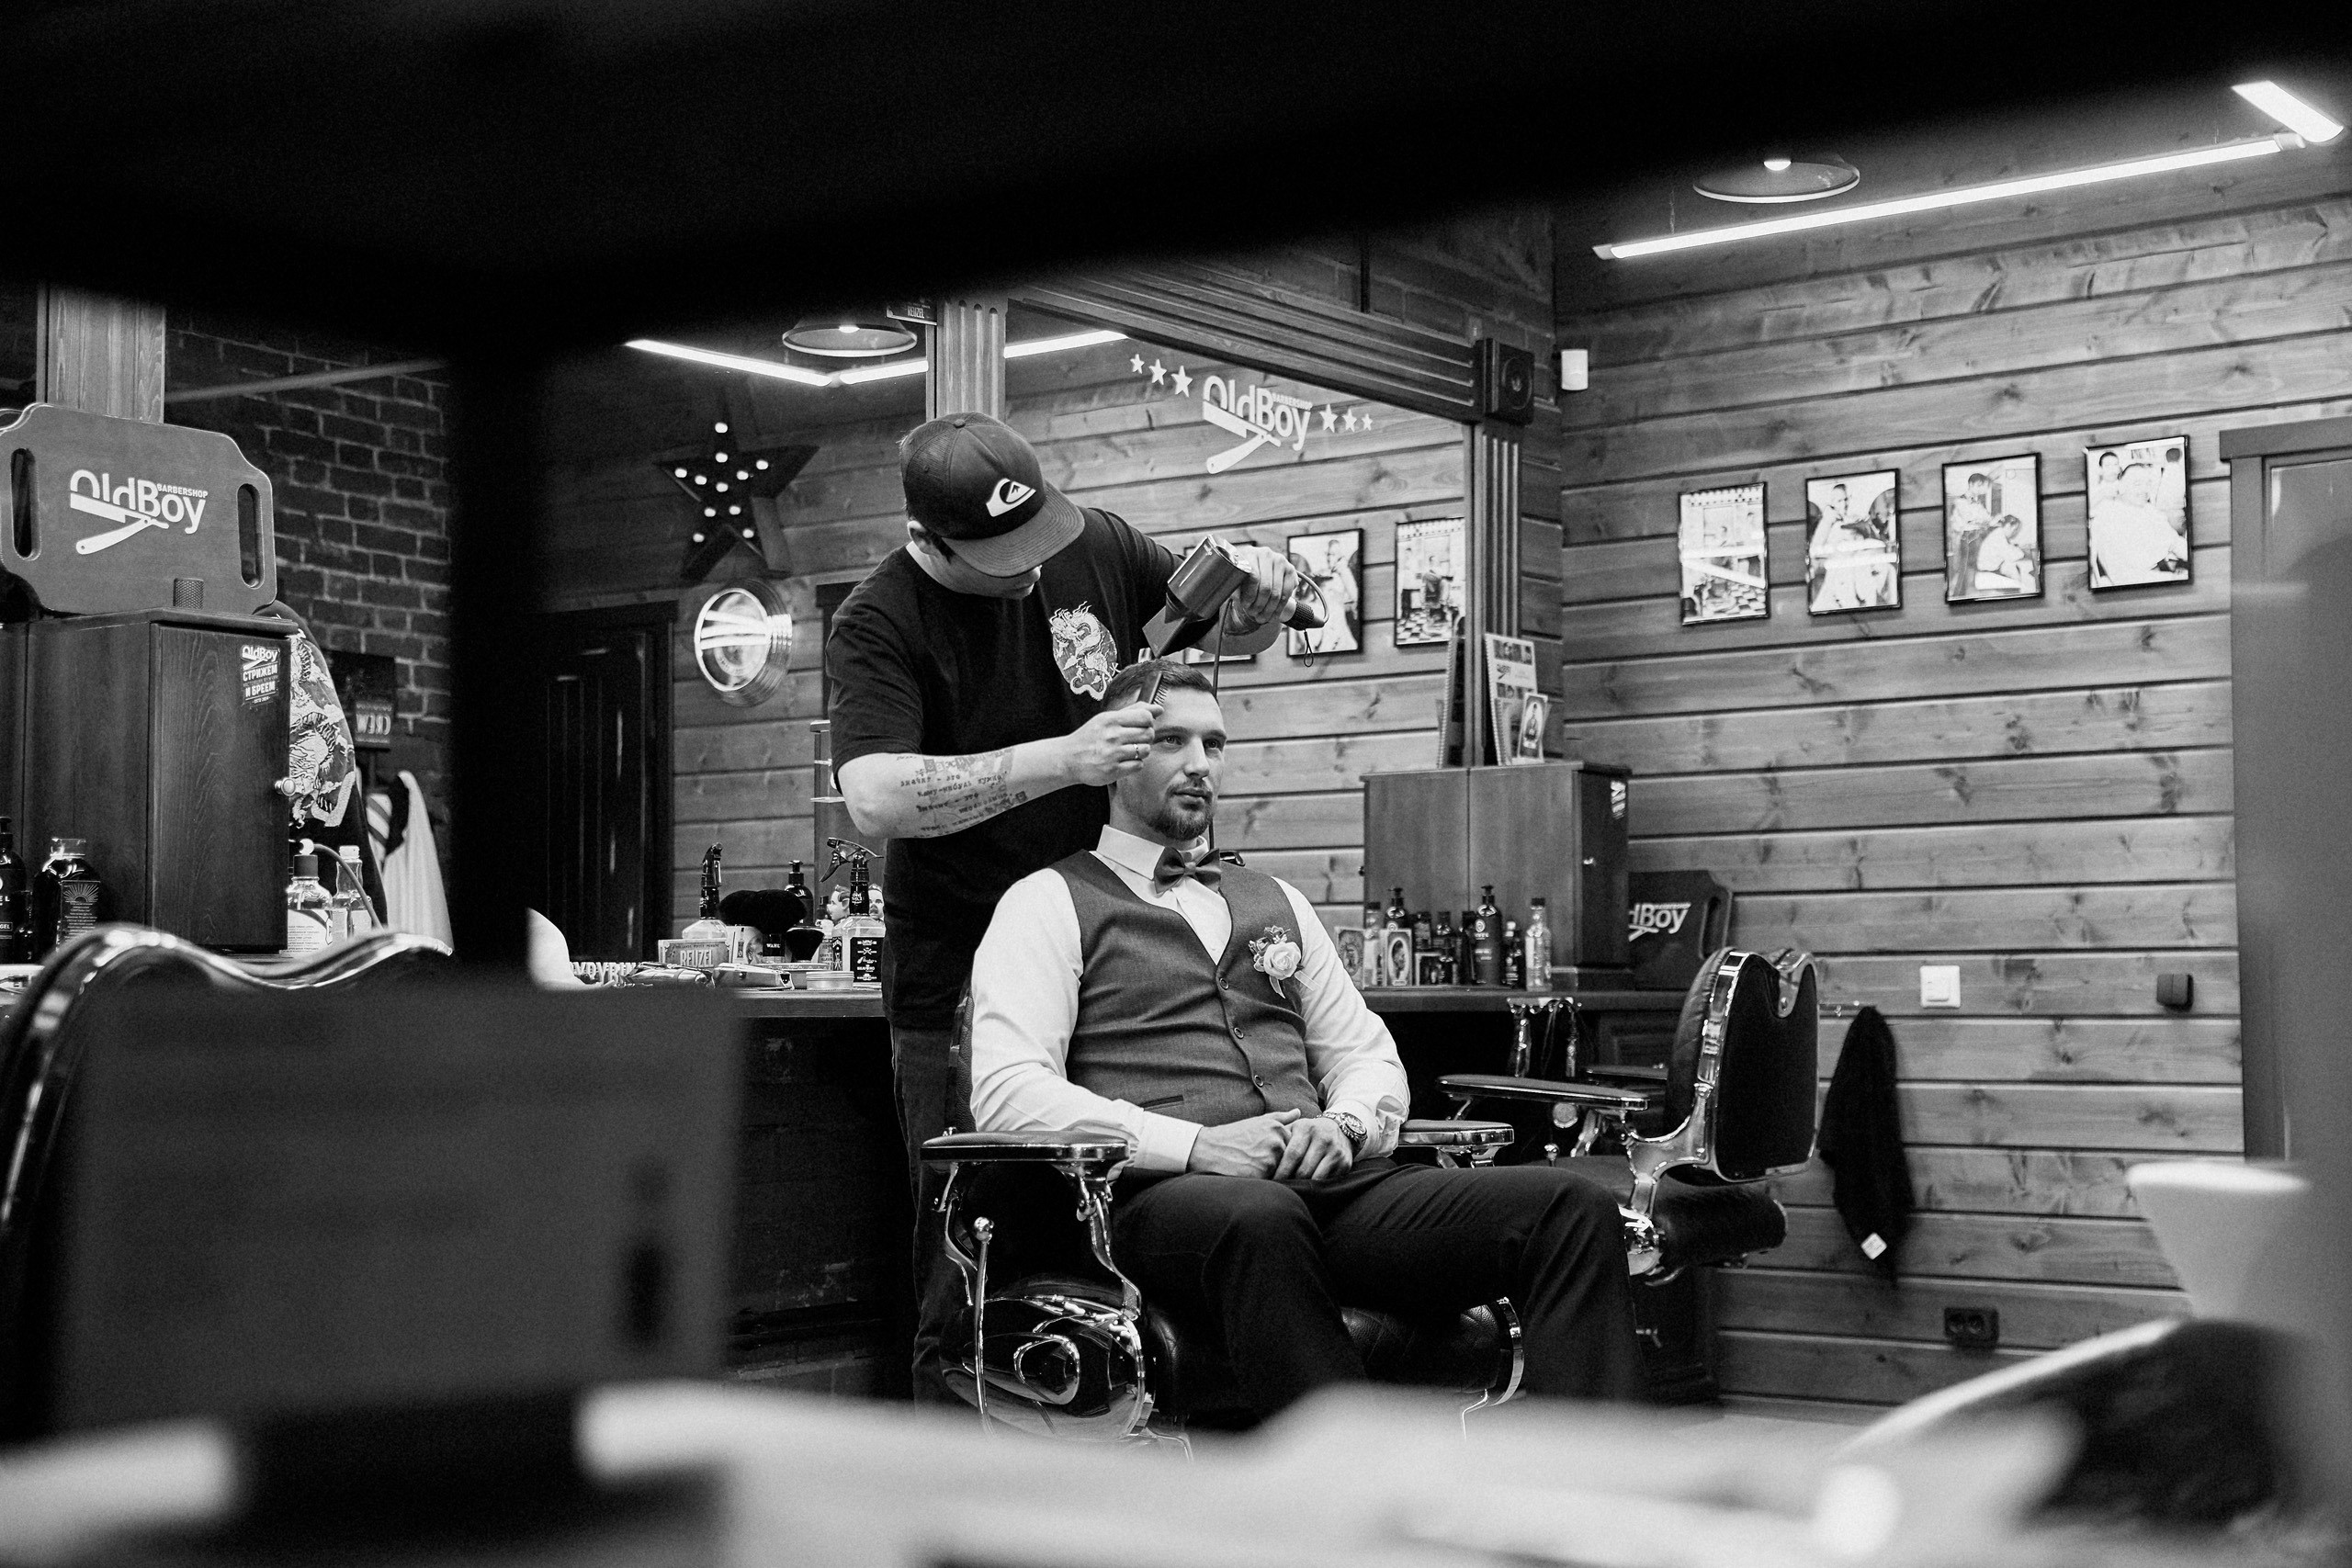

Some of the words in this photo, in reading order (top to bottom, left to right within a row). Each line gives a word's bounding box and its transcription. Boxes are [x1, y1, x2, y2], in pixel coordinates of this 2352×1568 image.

[1204, 375, 1311, 451] OldBoy
[156, 483, 209, 498] BARBERSHOP
[70, 469, 206, 534] OldBoy
[242, 646, 278, 662] OldBoy
[243, 664, 278, 682] СТРИЖЕМ
[245, 687, 252, 697] И
[252, 681, 277, 695] БРЕЕМ
[1629, 904, 1689, 934] dBoy
[680, 950, 714, 967] REUZEL
